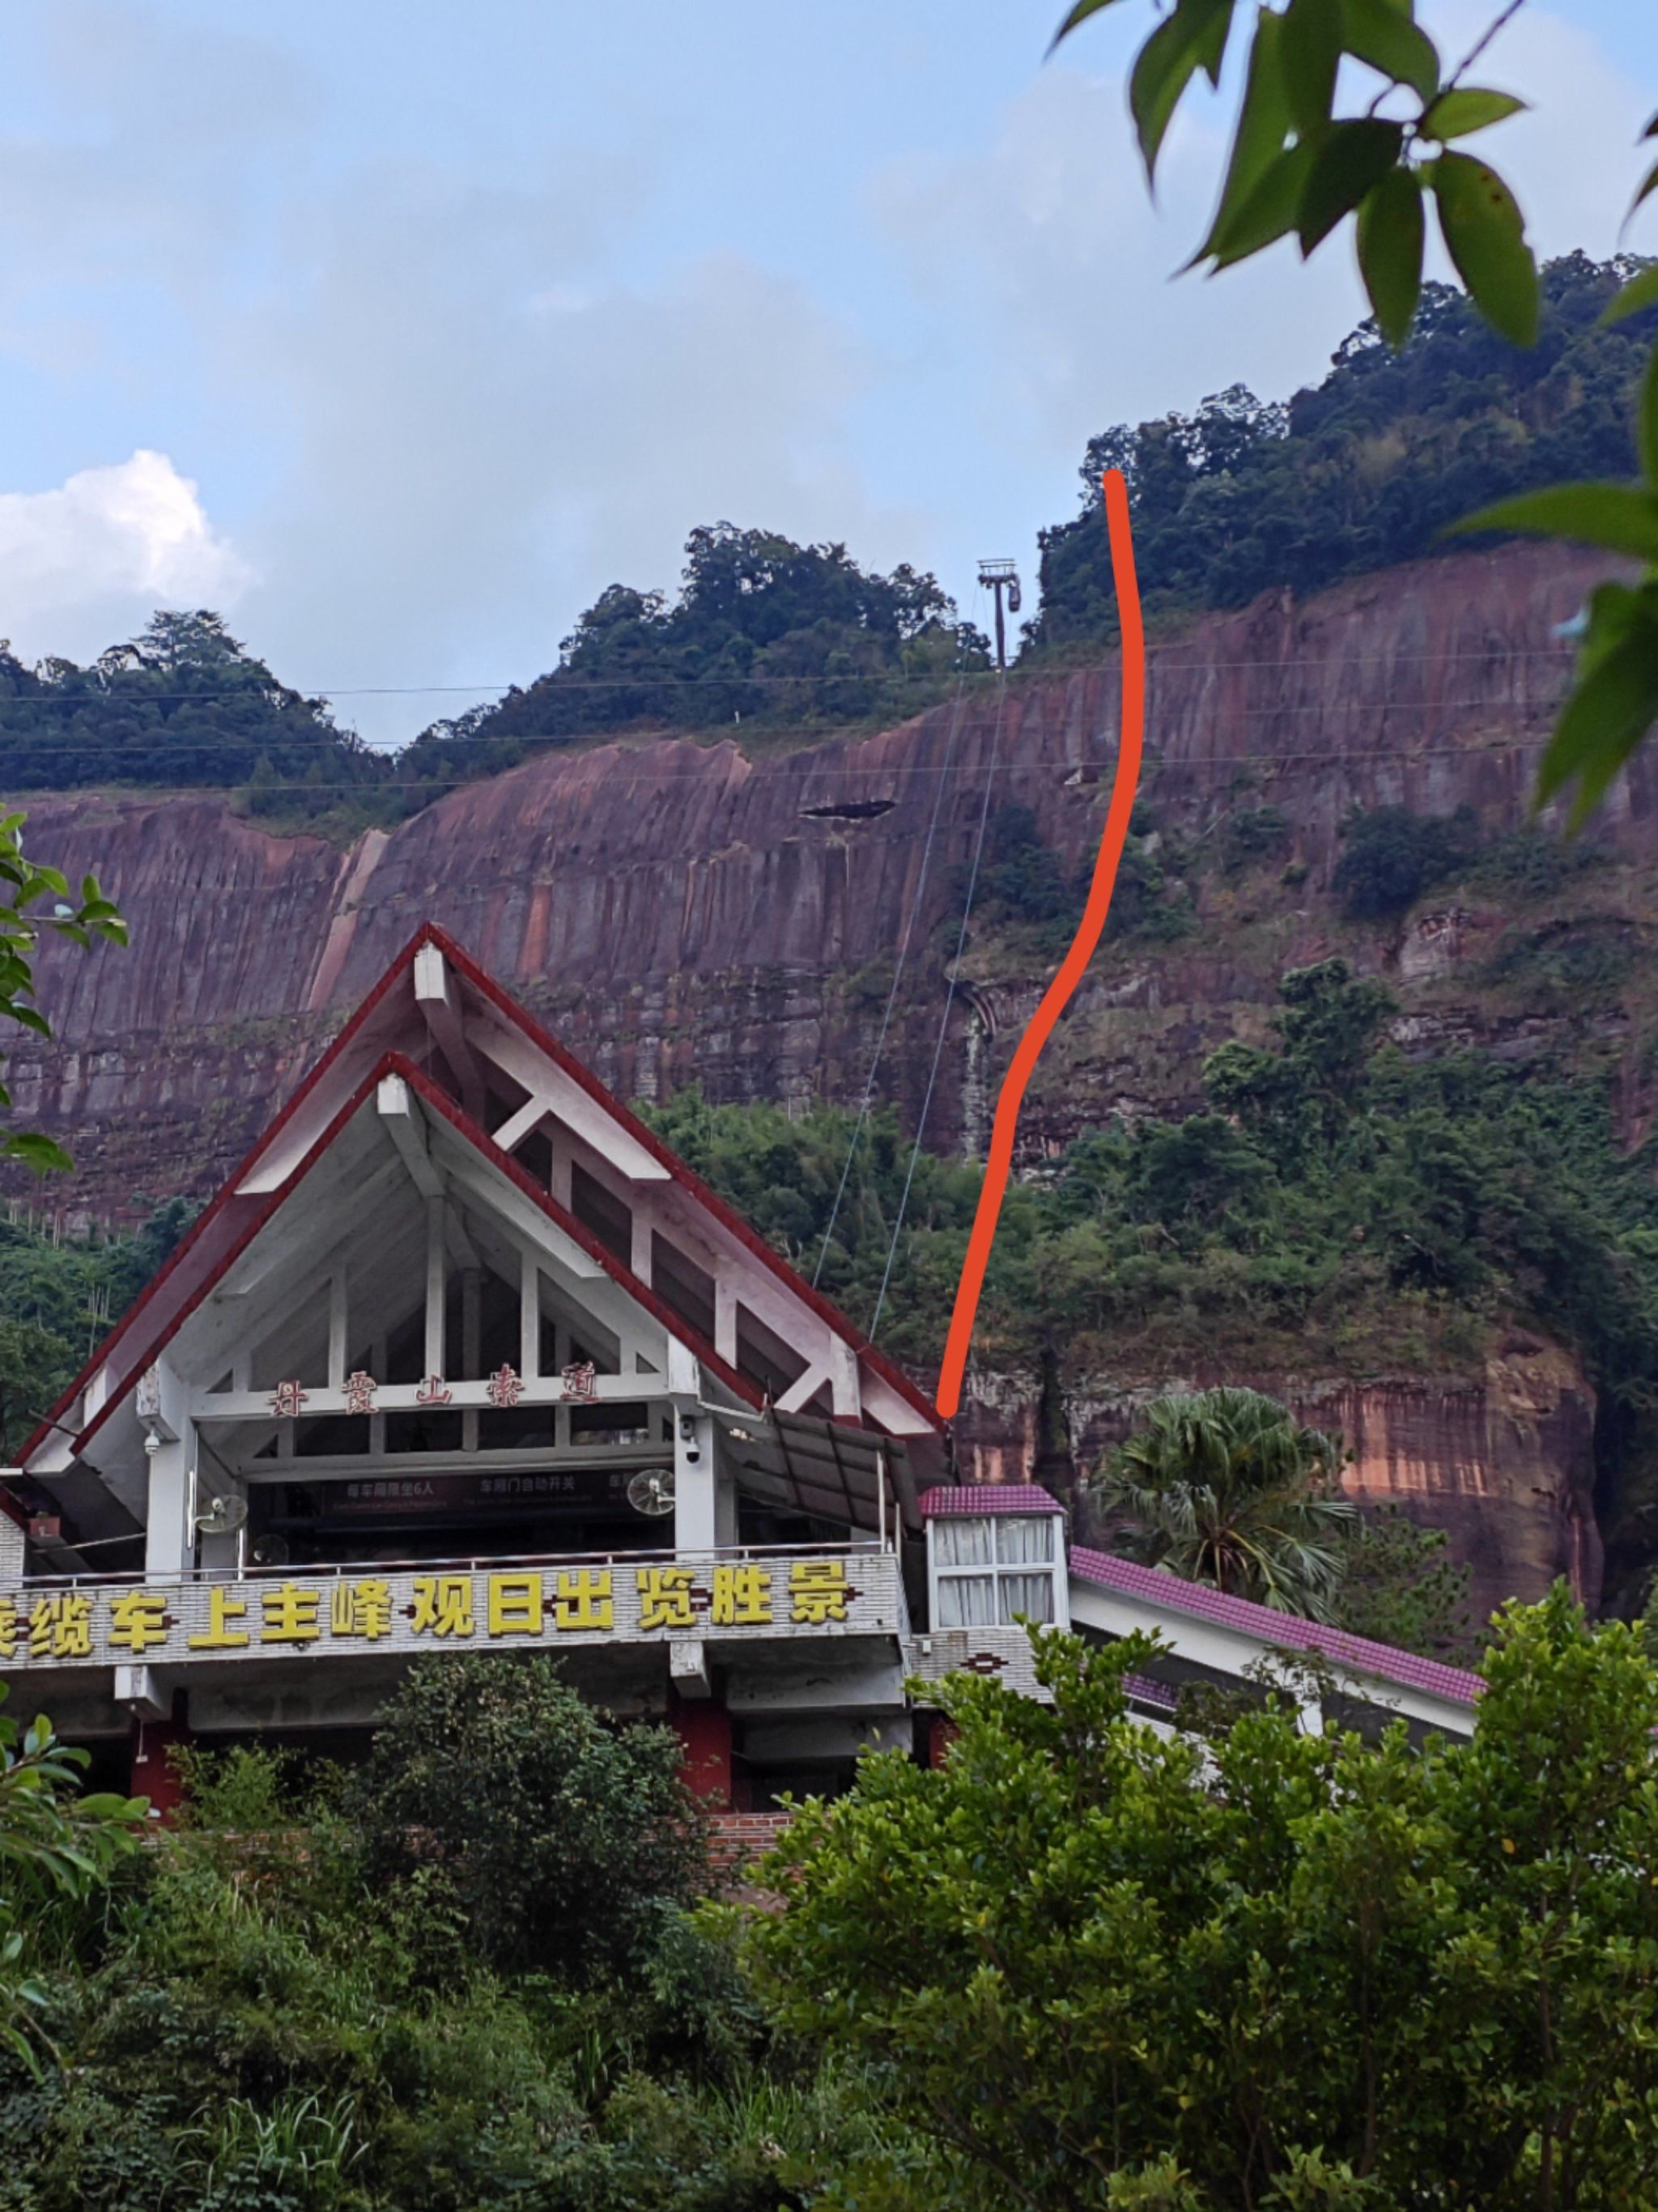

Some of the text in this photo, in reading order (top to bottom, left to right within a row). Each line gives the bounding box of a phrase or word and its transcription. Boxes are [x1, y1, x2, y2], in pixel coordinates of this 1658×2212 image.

[266, 1360, 601, 1418] 丹霞山索道
